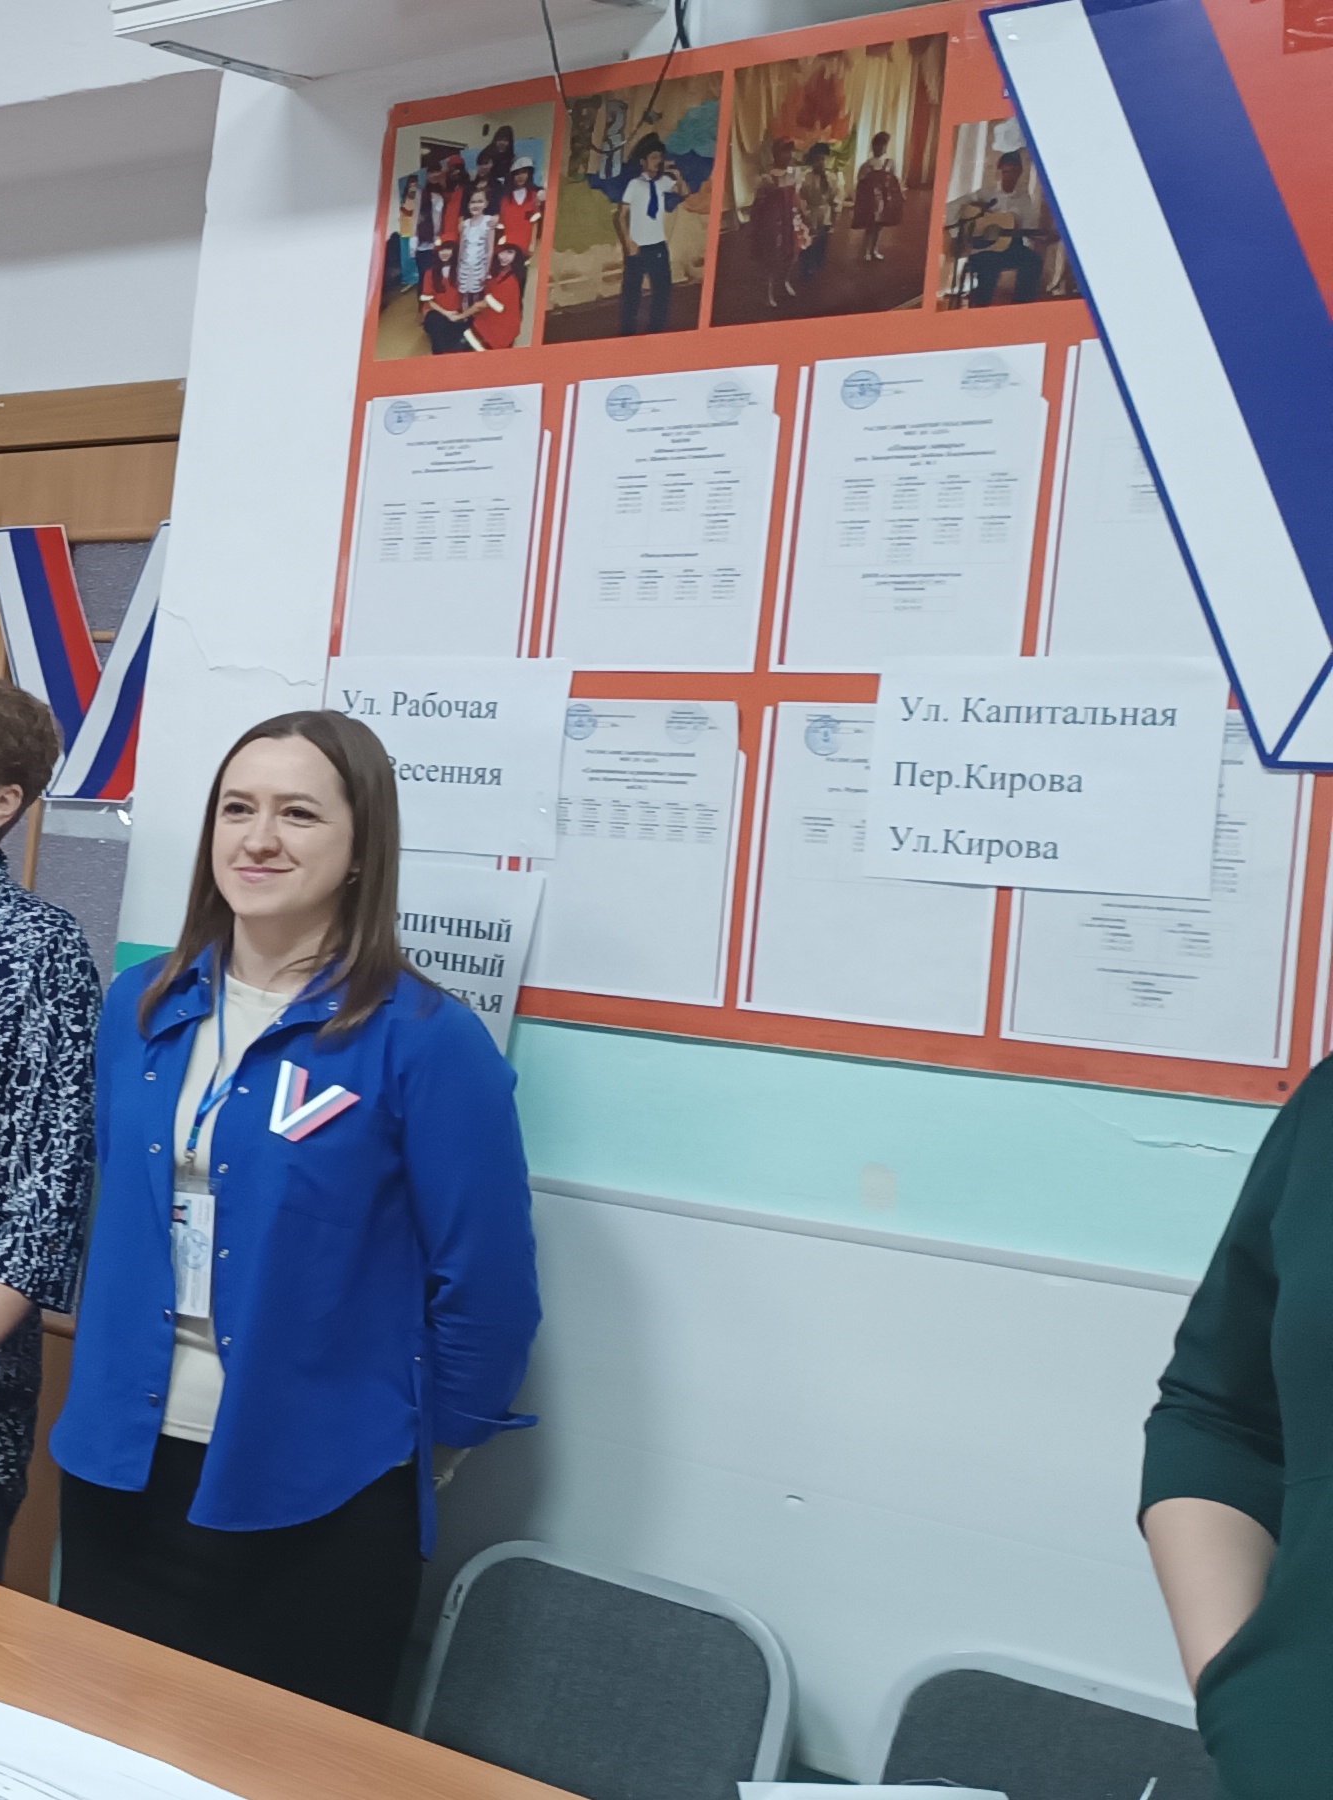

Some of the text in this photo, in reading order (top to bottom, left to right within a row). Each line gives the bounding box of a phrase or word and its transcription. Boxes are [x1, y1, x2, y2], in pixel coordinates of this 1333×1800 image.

[341, 689, 498, 720] Ул. Рабочая
[900, 696, 1177, 726] Ул. Капитальная
[893, 761, 1083, 798] Пер.Кирова
[889, 826, 1059, 864] Ул.Кирова
[395, 911, 512, 943] ПИЧНЫЙ
[399, 946, 505, 978] ТОЧНЫЙ
